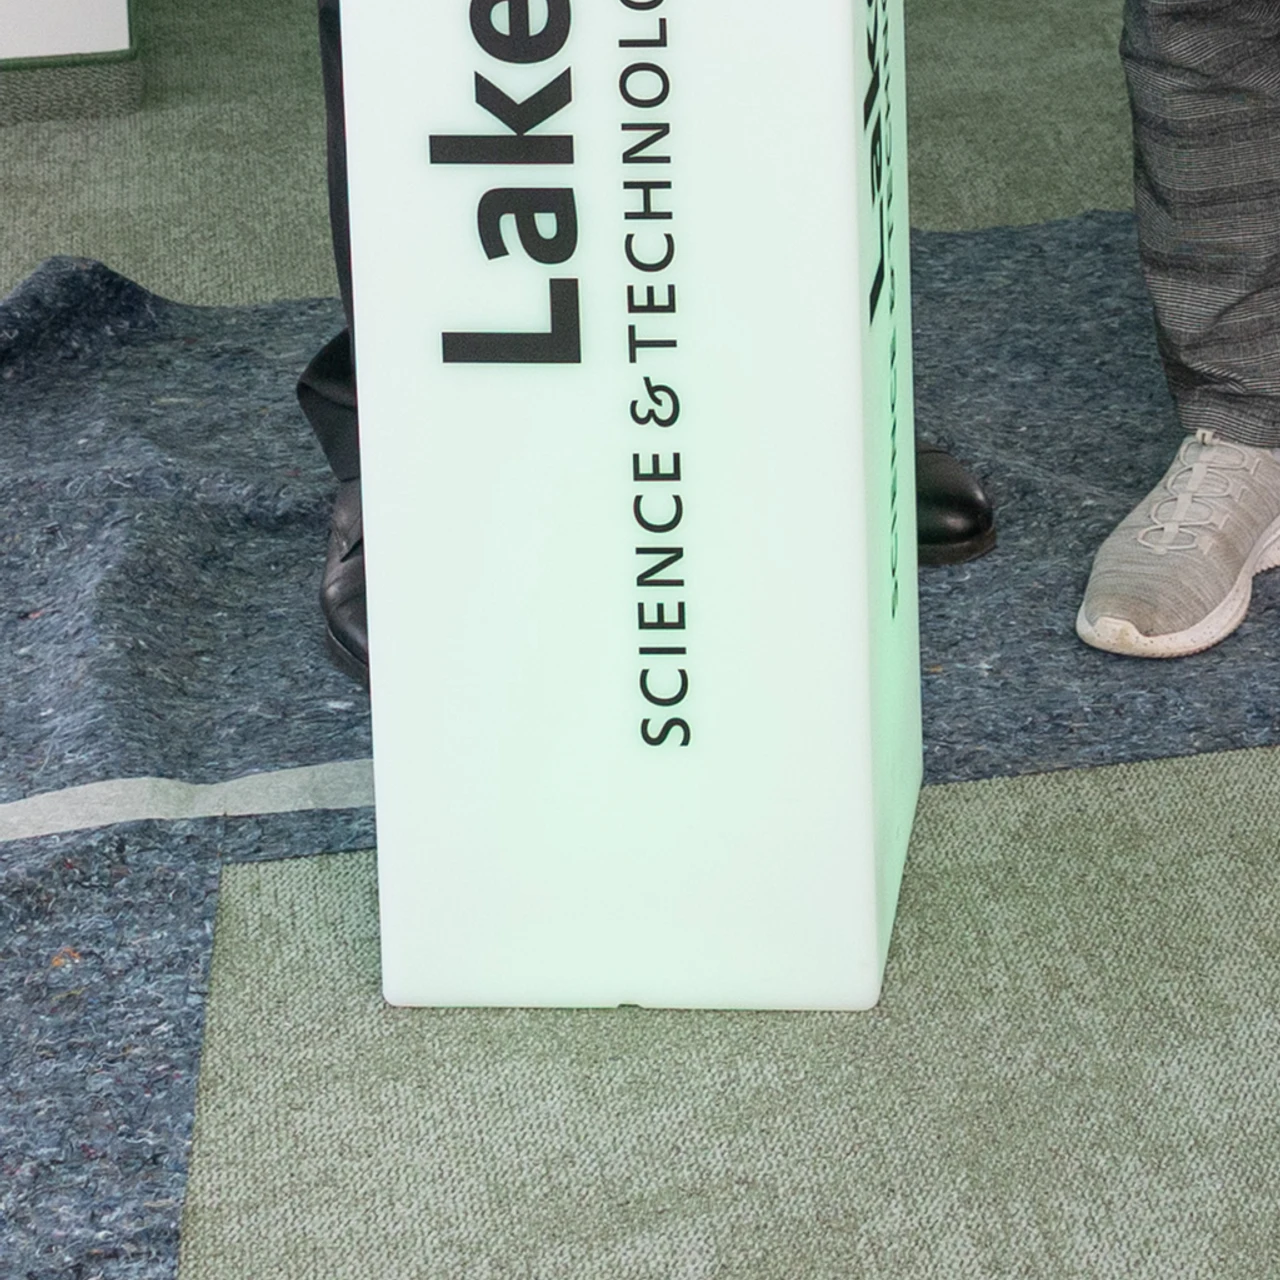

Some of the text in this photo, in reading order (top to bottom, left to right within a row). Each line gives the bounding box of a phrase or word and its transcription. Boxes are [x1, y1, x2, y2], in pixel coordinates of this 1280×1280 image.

[629, 376, 681, 428] &
[889, 326, 899, 619] SCIENCE
[632, 452, 691, 747] SCIENCE
